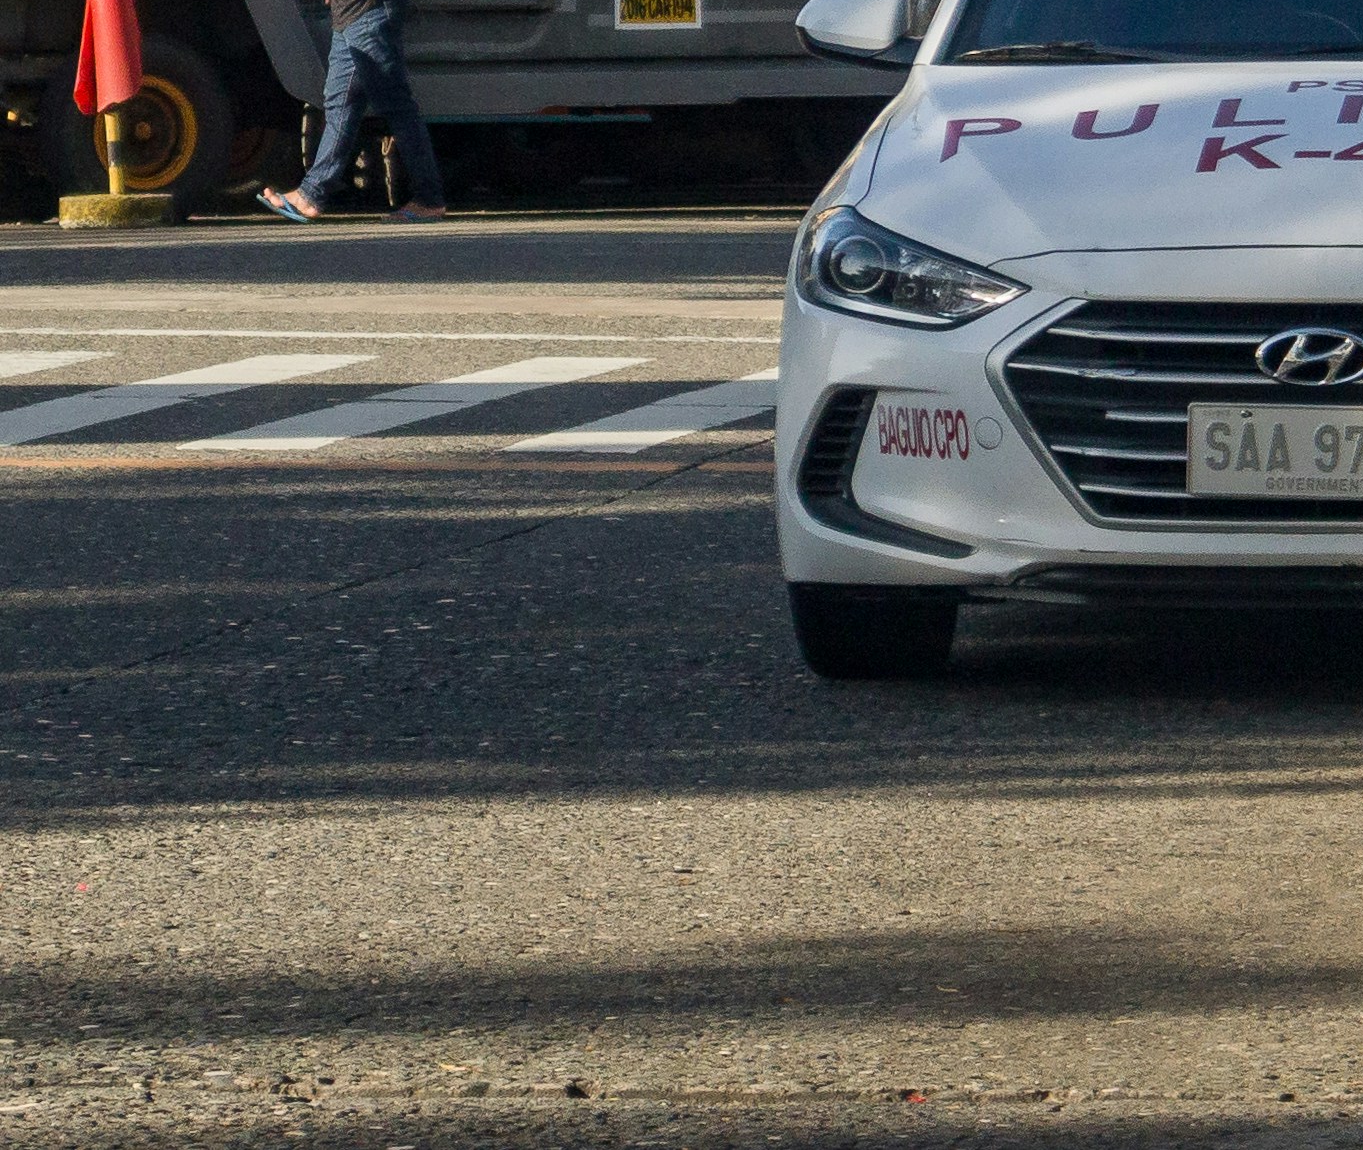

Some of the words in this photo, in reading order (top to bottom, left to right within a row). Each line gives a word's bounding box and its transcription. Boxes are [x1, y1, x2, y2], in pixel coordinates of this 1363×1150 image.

[877, 404, 933, 460] BAGUIO
[933, 408, 970, 461] CPO
[1204, 421, 1292, 473] SAA
